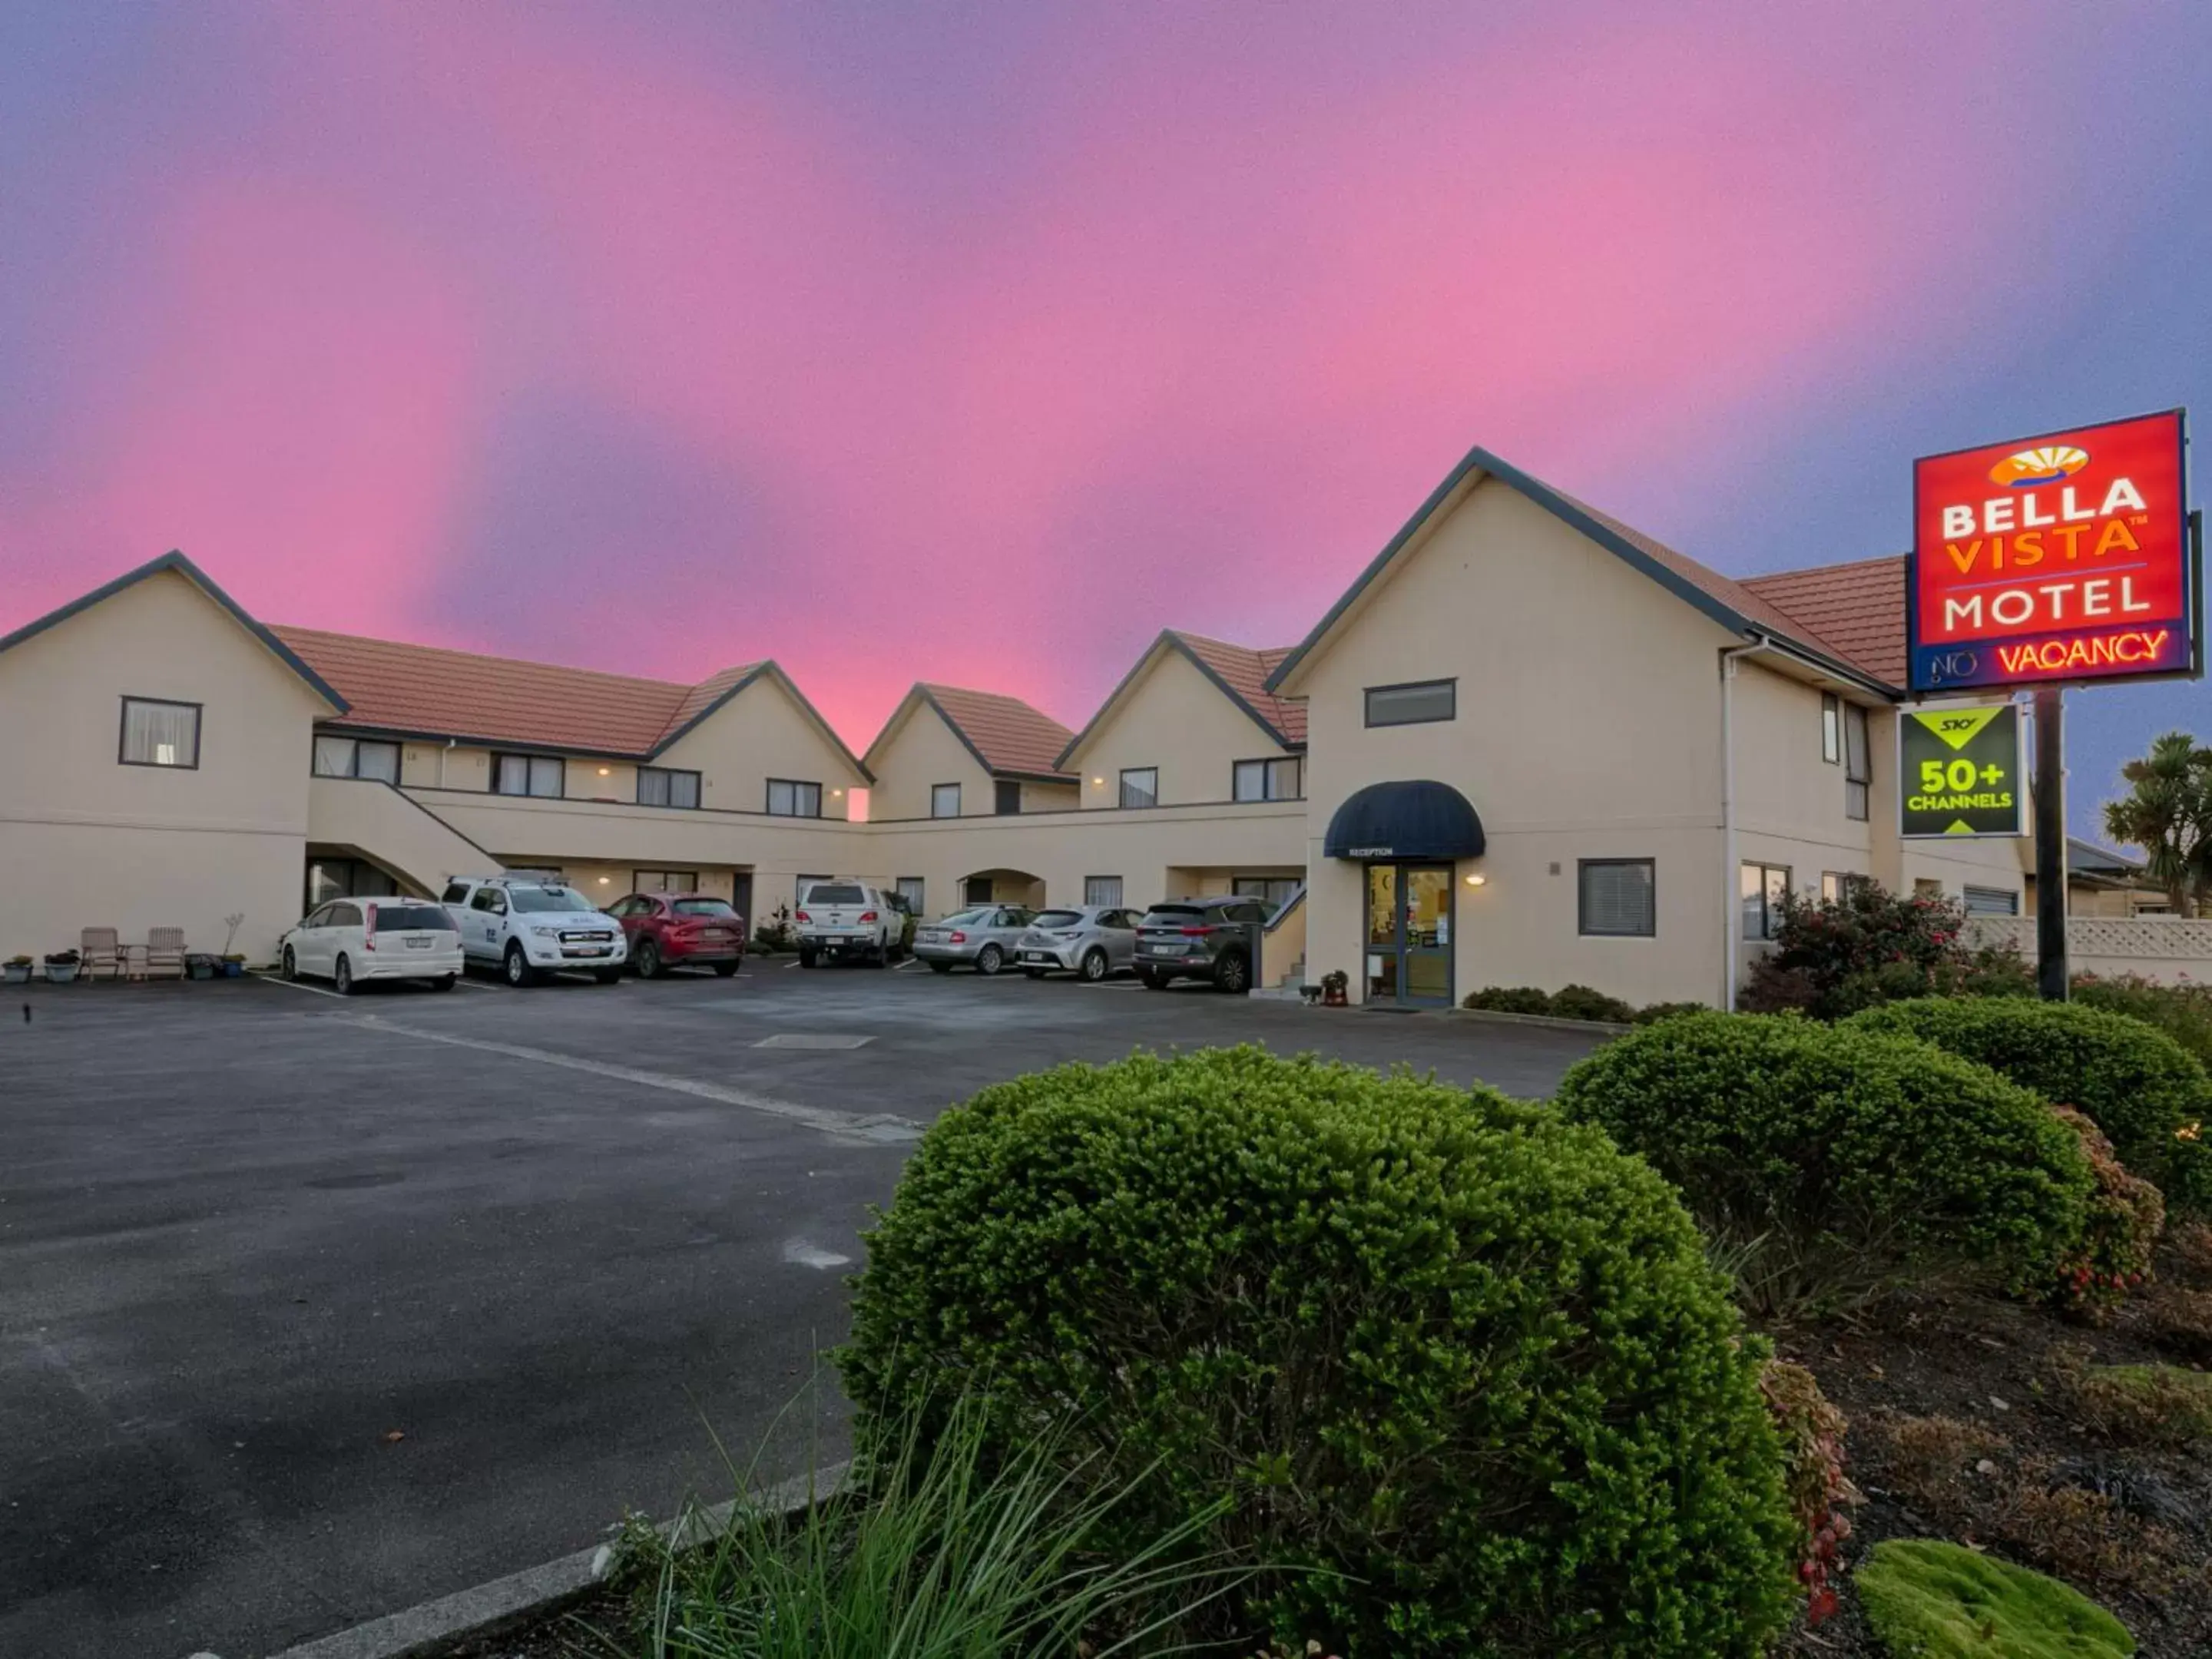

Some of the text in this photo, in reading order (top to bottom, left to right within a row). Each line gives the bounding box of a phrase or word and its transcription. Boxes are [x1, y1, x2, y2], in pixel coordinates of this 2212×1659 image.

[1943, 478, 2146, 538] BELLA
[1946, 519, 2140, 574] VISTA
[1945, 577, 2150, 631] MOTEL
[1932, 630, 2168, 677] NO VACANCY
[1940, 717, 1979, 731] SKY
[1921, 759, 2005, 793] 50+
[1908, 793, 2012, 811] CHANNELS
[1349, 847, 1393, 857] RECEPTION
